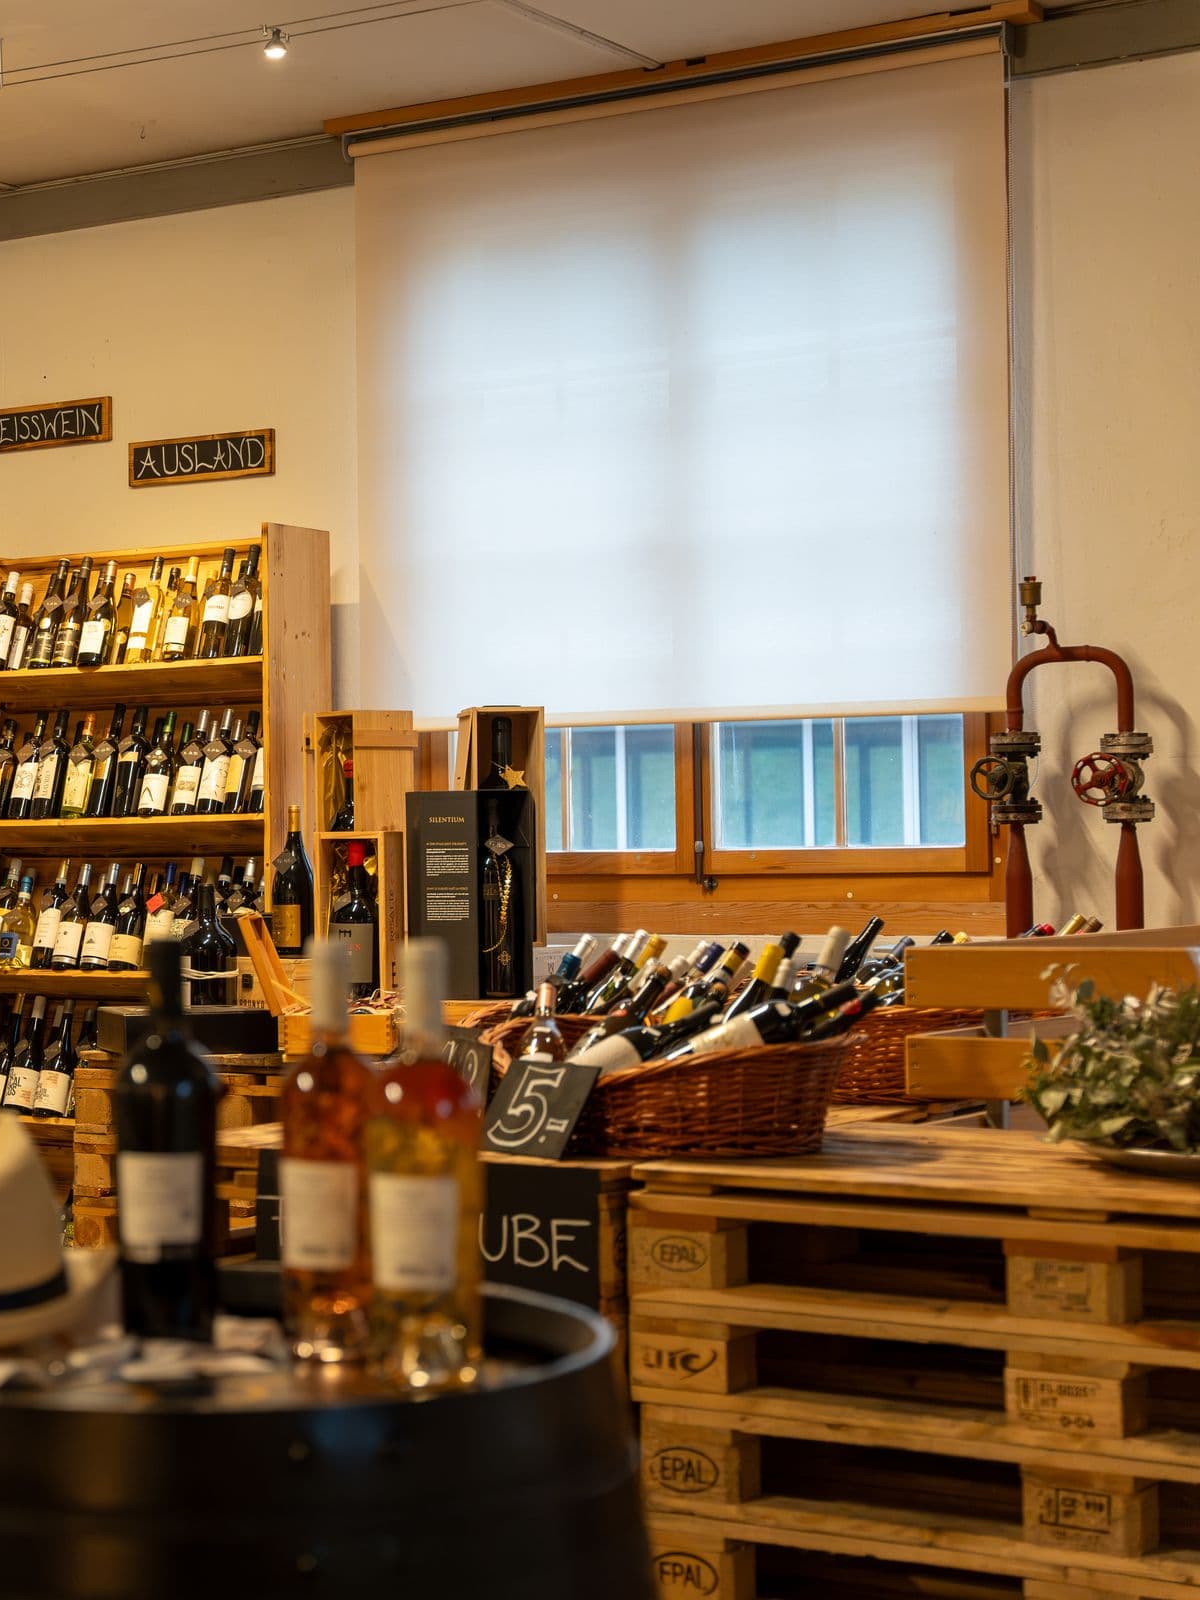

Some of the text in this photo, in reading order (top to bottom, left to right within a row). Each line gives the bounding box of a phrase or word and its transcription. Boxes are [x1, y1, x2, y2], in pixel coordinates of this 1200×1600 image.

[137, 438, 264, 479] AUSLAND
[428, 816, 465, 824] SILENTIUM
[660, 1243, 701, 1265] EPAL
[660, 1456, 711, 1485] EPAL
